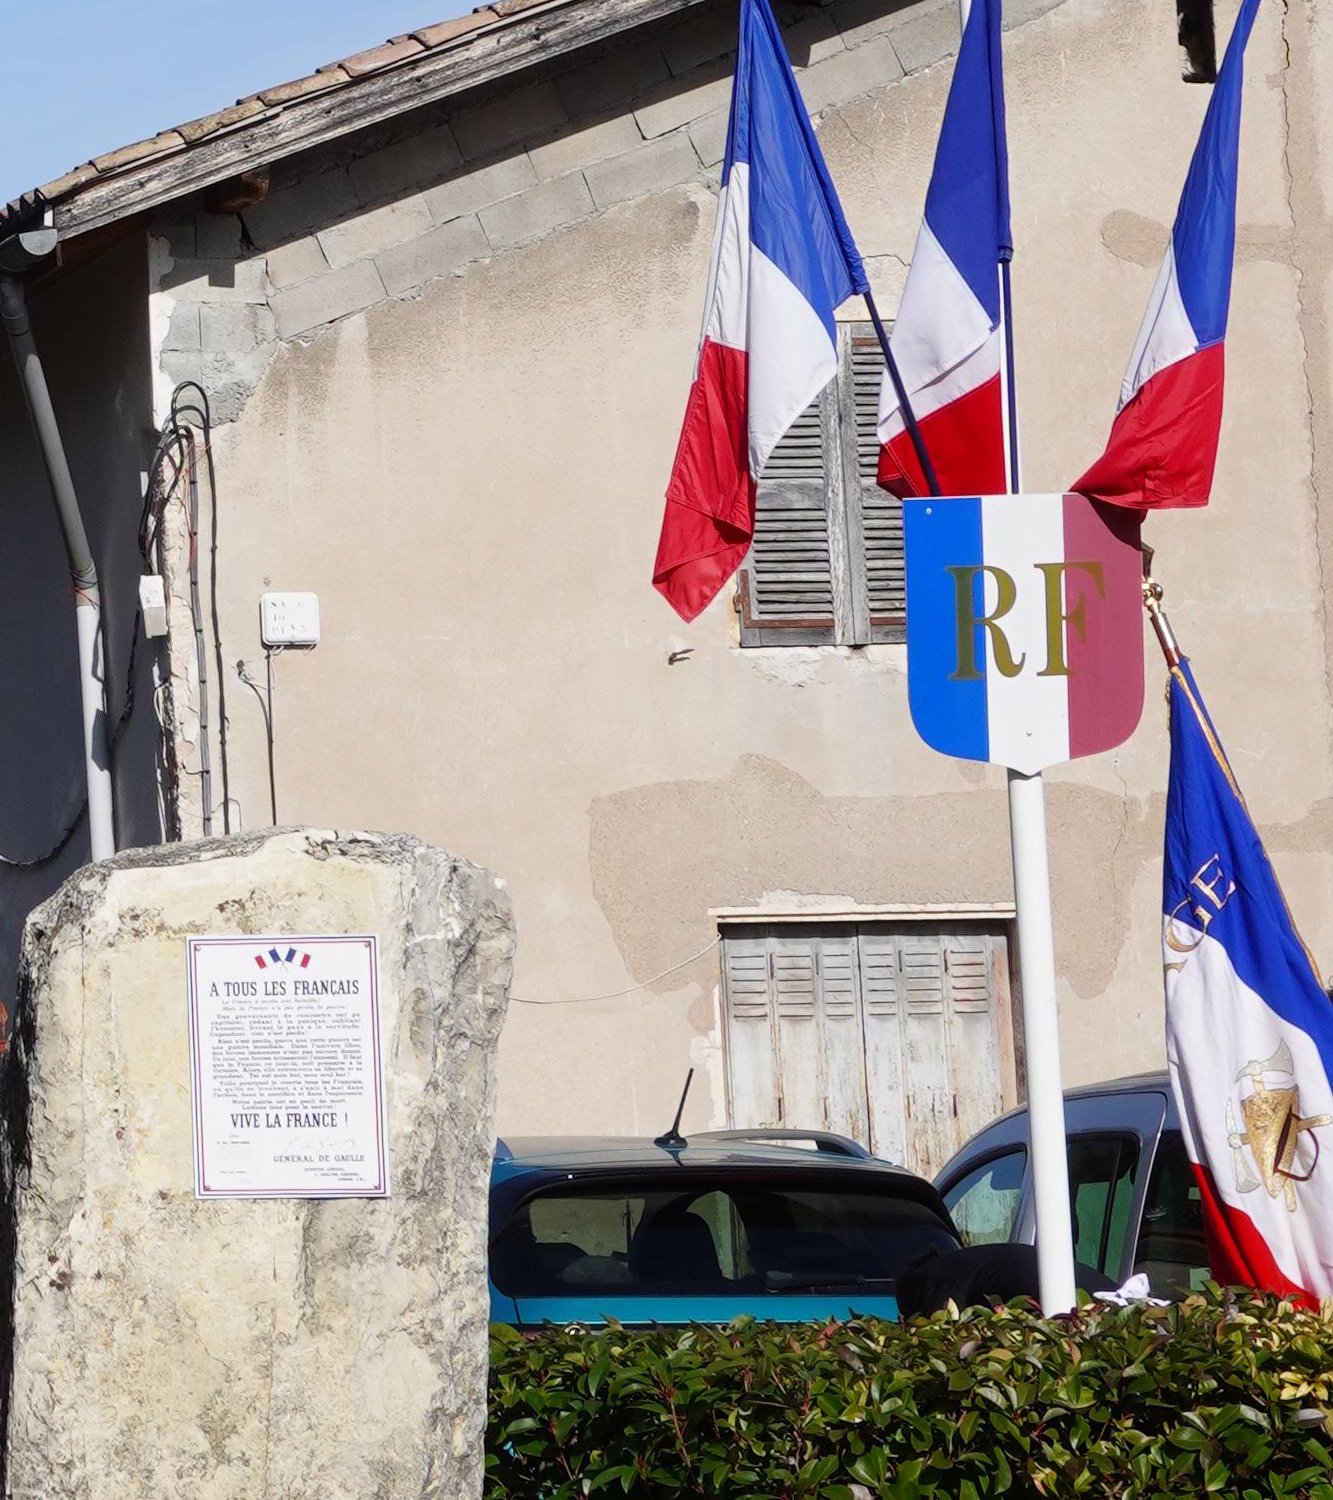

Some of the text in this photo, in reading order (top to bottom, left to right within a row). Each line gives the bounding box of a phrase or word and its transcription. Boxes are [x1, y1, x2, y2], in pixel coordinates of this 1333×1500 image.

[944, 560, 1106, 681] RF
[210, 979, 359, 997] A TOUS LES FRANÇAIS
[231, 1113, 260, 1128] VIVE
[266, 1112, 282, 1128] LA
[286, 1112, 337, 1128] FRANCE
[318, 1153, 330, 1162] DE
[334, 1153, 366, 1162] GAULLE
